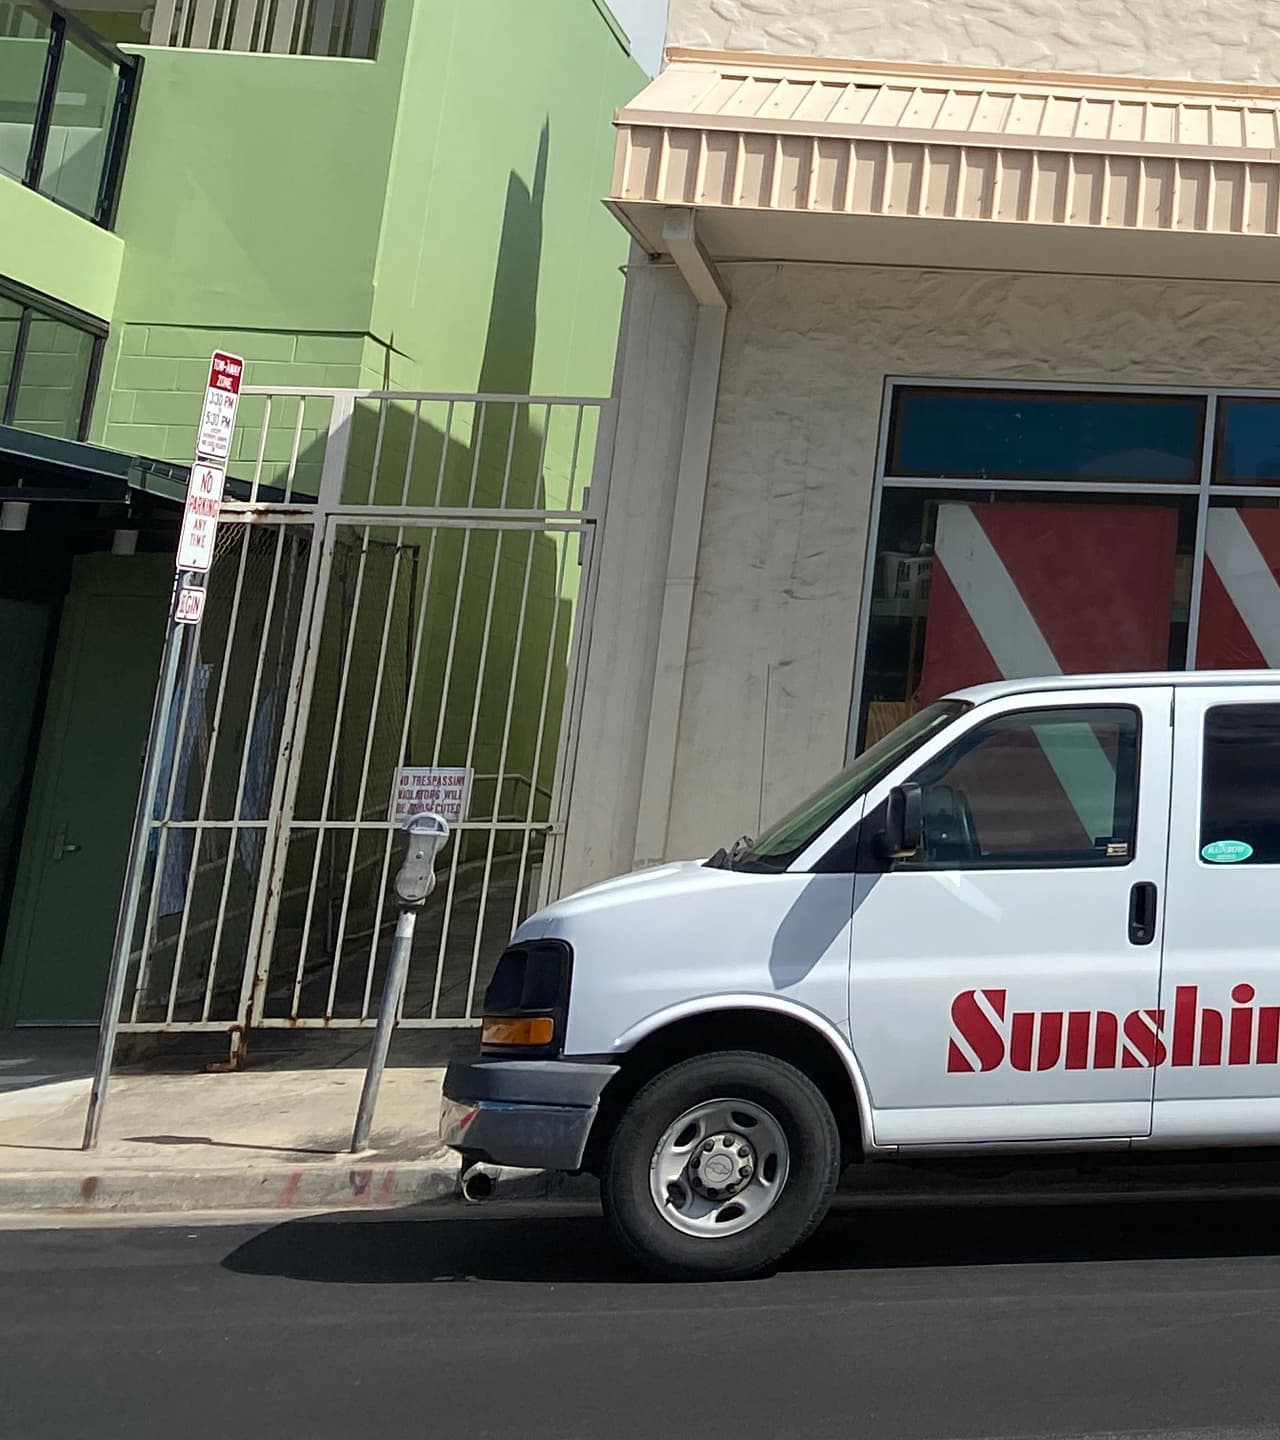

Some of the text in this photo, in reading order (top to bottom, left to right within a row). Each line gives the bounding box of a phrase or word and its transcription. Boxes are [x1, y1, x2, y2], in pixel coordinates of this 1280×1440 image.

[223, 395, 235, 409] PM
[221, 415, 231, 429] PM
[200, 473, 214, 494] NO
[188, 495, 218, 518] PARKING
[193, 518, 207, 532] ANY
[190, 533, 207, 548] TIME
[412, 775, 466, 786] TRESPASSIN
